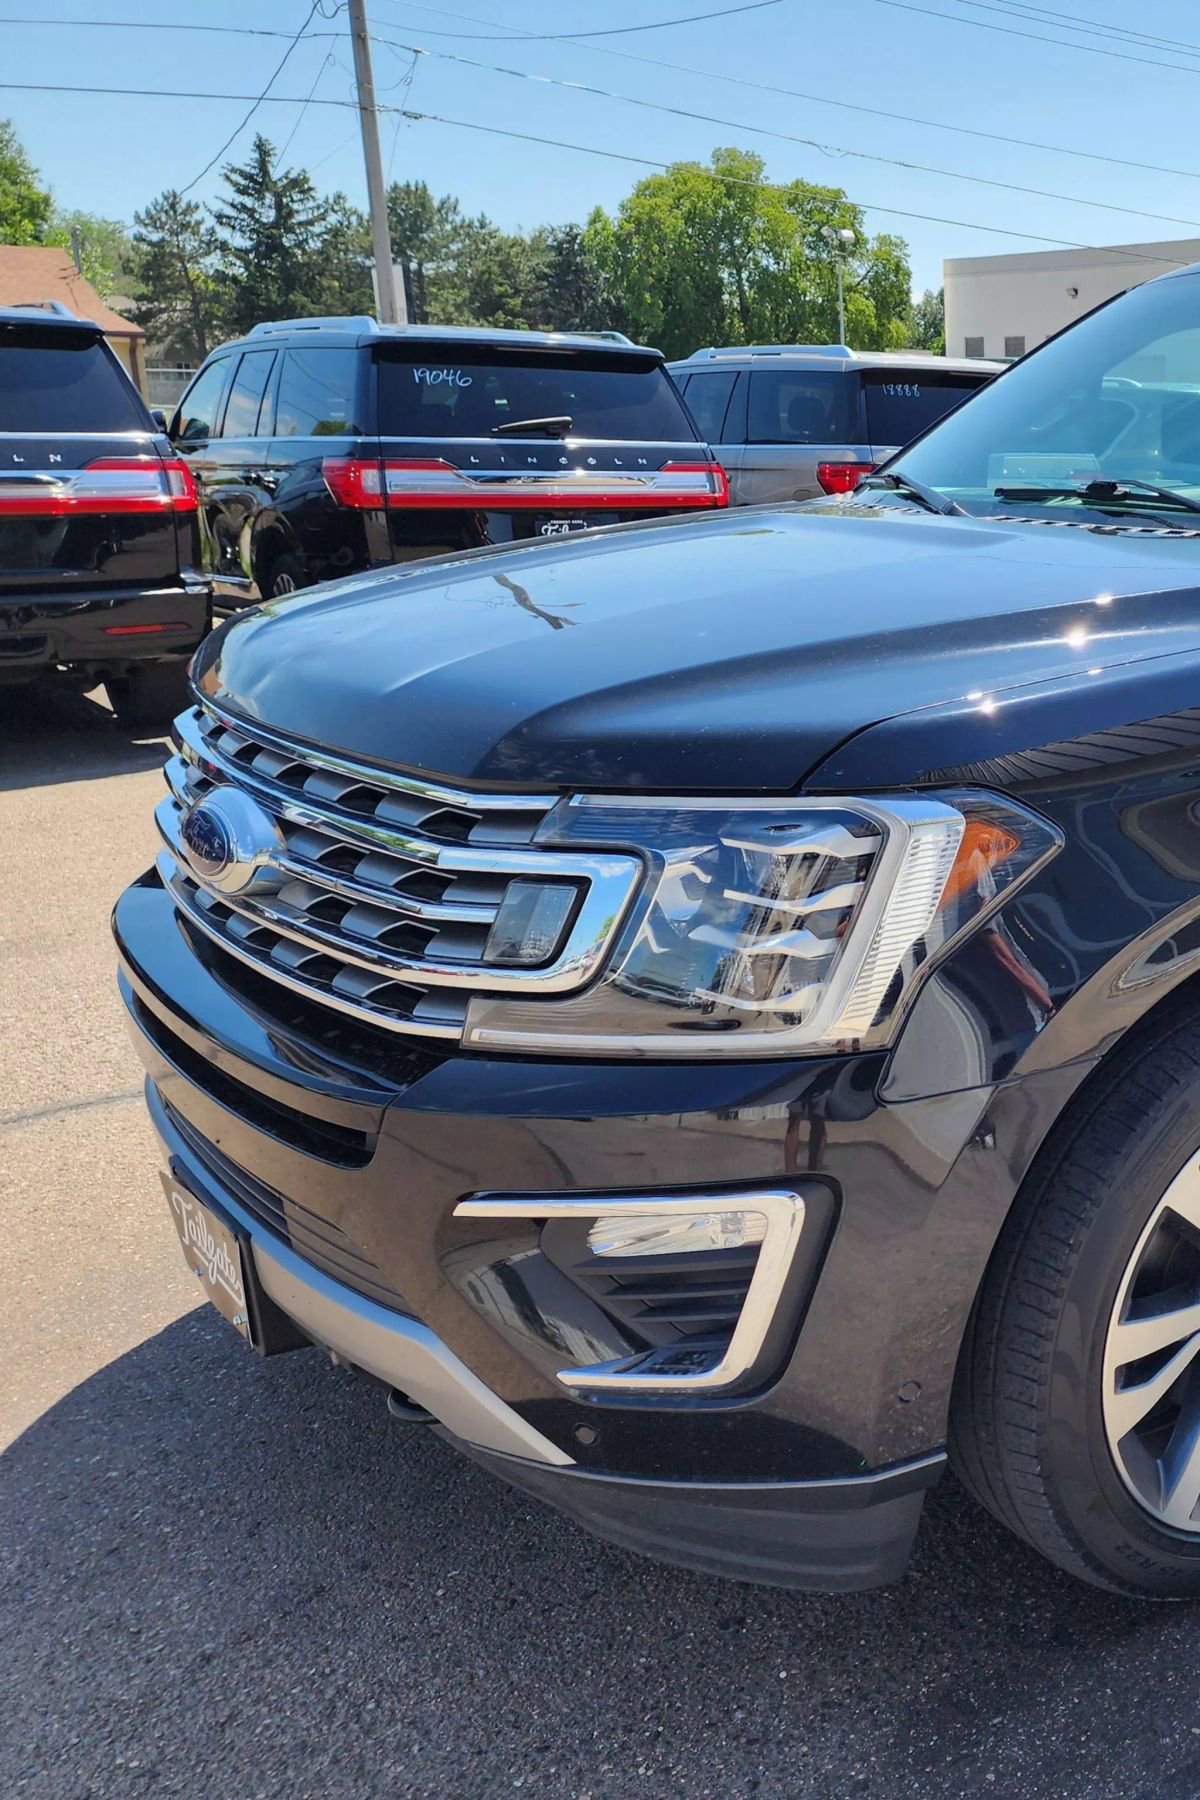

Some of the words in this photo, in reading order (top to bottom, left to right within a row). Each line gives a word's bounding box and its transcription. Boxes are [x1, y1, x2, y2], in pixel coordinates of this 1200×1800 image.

[412, 367, 473, 387] 19046
[882, 383, 920, 397] 18888
[470, 455, 648, 465] LINCOLN
